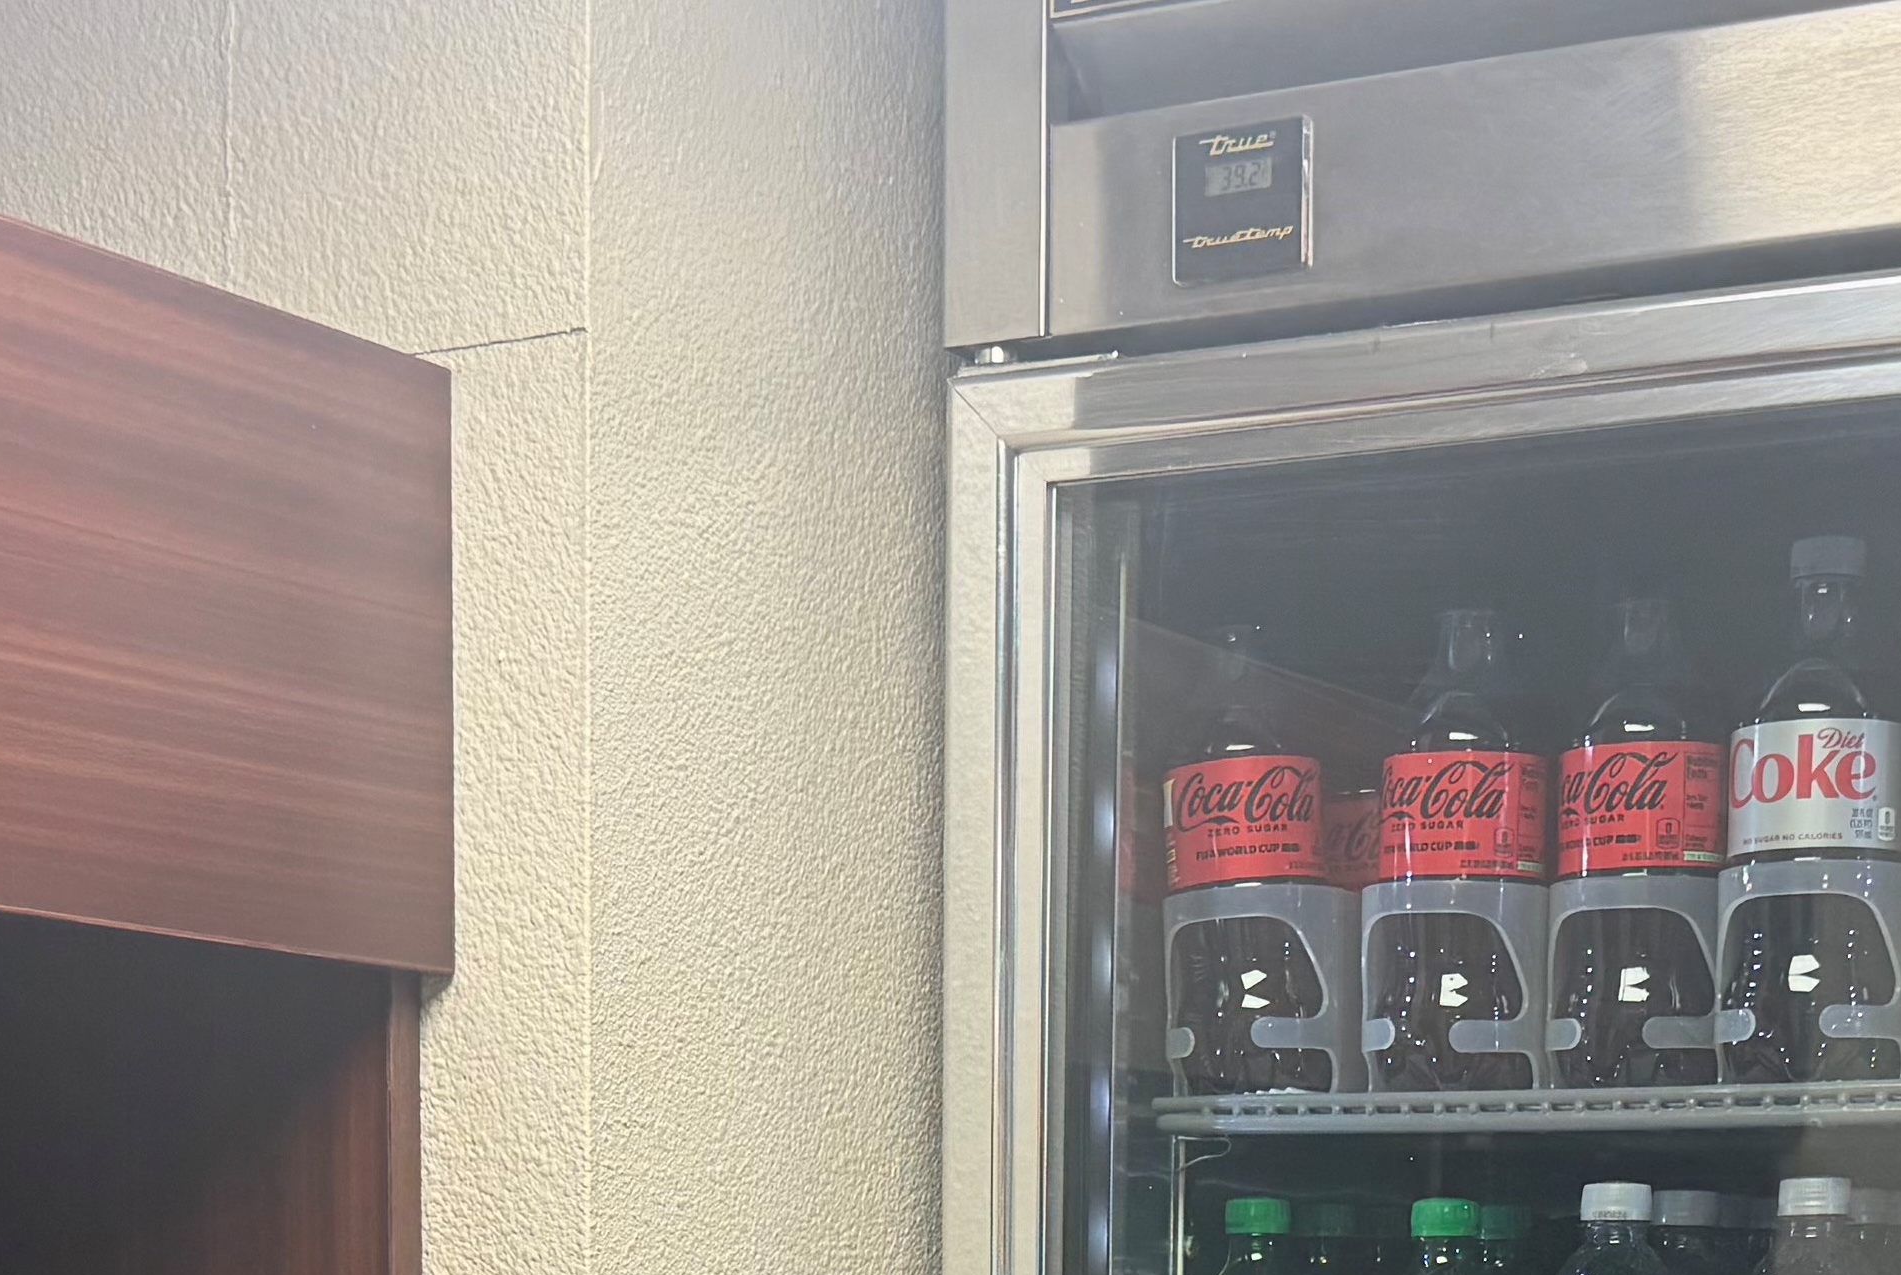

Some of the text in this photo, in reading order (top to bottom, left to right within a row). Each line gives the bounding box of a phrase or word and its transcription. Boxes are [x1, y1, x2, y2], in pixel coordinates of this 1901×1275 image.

[1817, 727, 1865, 752] Diet
[1730, 734, 1878, 809] Coke
[1177, 766, 1317, 832] Coca-Cola
[1207, 823, 1288, 837] ZERO SUGAR
